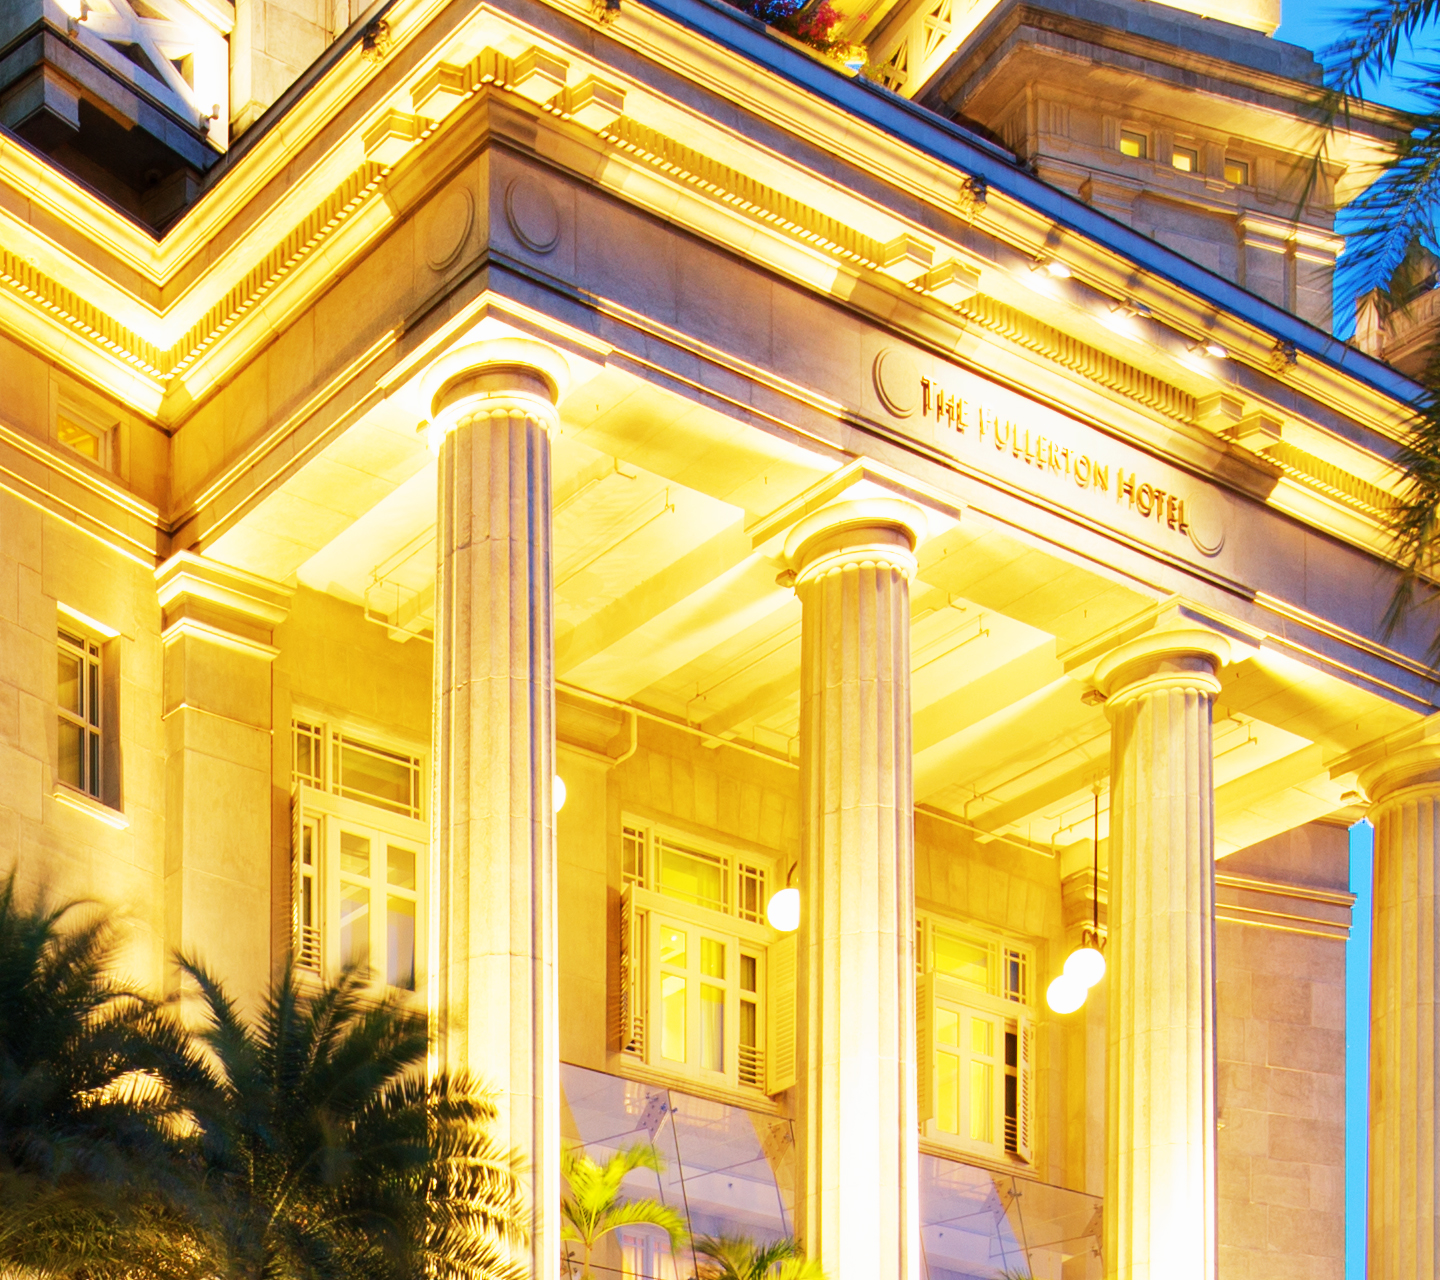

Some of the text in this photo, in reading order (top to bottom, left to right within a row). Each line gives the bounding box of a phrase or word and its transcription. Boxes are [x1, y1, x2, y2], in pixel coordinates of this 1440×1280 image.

[920, 375, 1188, 536] THE FULLERTON HOTEL
